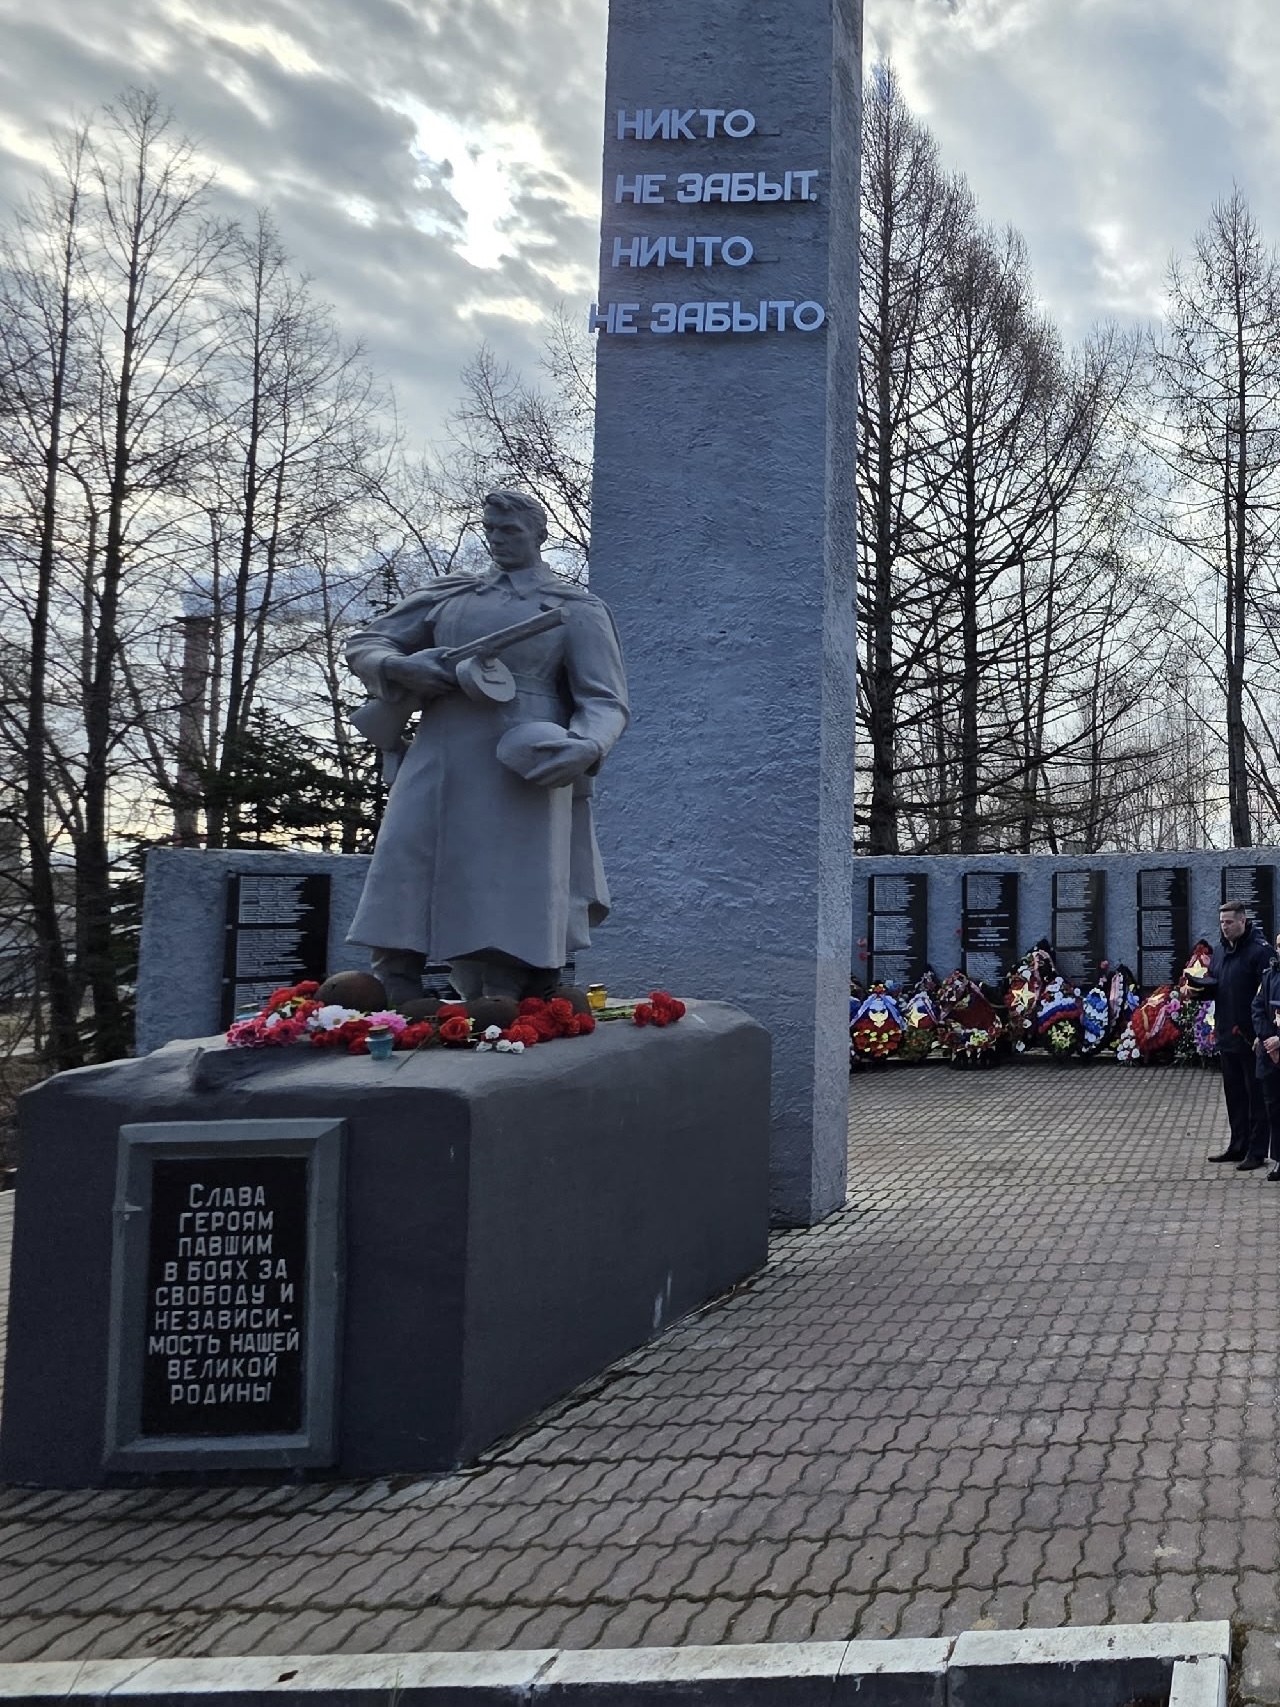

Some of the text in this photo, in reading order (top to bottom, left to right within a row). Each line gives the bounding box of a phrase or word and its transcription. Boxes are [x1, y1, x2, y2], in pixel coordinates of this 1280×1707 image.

[617, 109, 755, 139] НИКТО
[615, 174, 666, 203] НЕ
[612, 236, 753, 267] НИЧТО
[588, 301, 825, 334] НЕ ЗАБЫТО
[178, 1210, 274, 1233] ГЕРОЯМ
[178, 1234, 273, 1257] ПАВШИМ
[164, 1259, 288, 1282] В БОЯХ ЗА
[155, 1284, 294, 1306] СВОБОДУ И
[155, 1308, 293, 1331] НЕЗАВИСИ-
[149, 1327, 299, 1355] МОСТЬ НАШЕЙ
[167, 1353, 278, 1380] ВЕЛИКОЙ
[170, 1382, 272, 1405] РОДИНЫ
